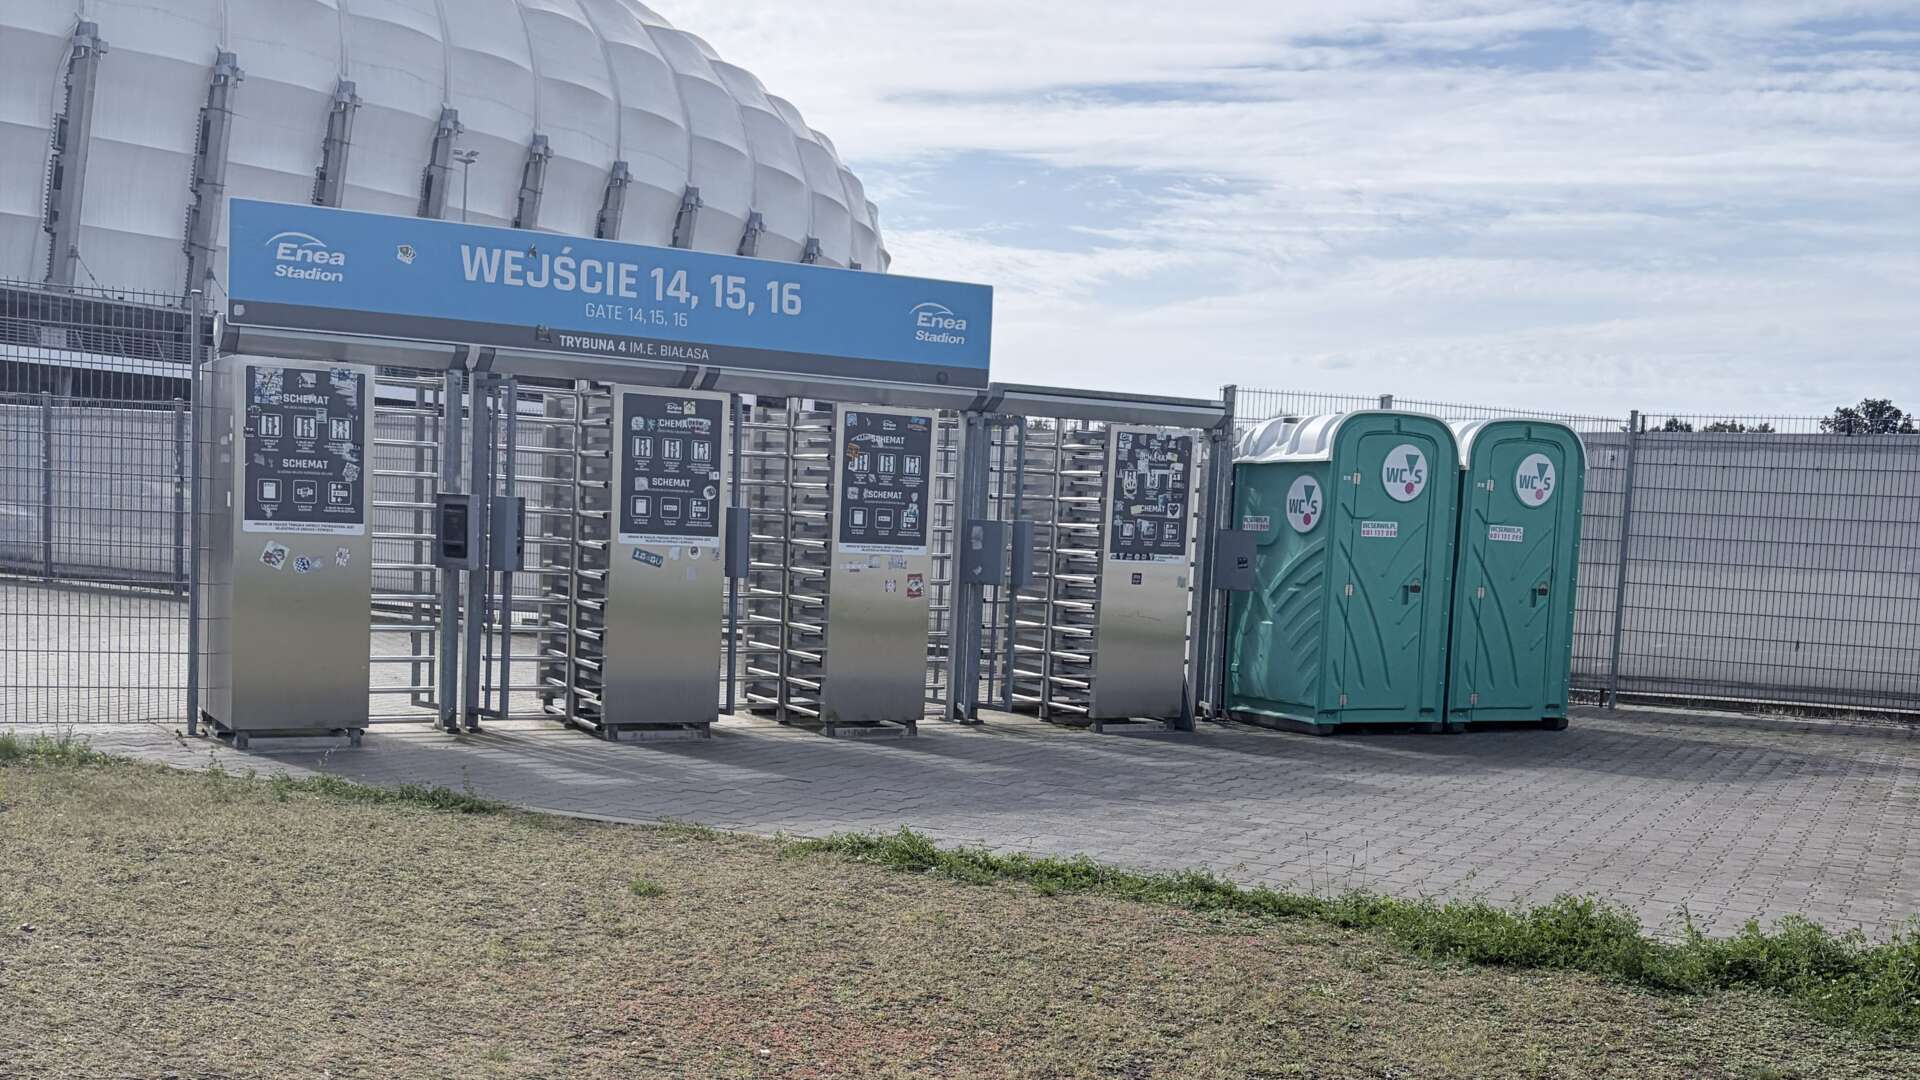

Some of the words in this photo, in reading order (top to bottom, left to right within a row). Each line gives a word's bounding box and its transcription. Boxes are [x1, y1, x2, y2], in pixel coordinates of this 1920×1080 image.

[276, 243, 345, 265] Enea
[274, 264, 343, 282] Stadion
[461, 244, 638, 299] WEJŚCIE
[650, 267, 699, 309] 14,
[710, 274, 755, 316] 15,
[766, 280, 803, 316] 16
[585, 303, 622, 321] GATE
[627, 306, 647, 325] 14,
[649, 309, 668, 326] 15,
[673, 312, 688, 327] 16
[917, 312, 966, 330] Enea
[915, 330, 964, 345] Stadion
[559, 335, 615, 351] TRYBUNA
[618, 340, 627, 353] 4
[629, 342, 657, 356] IM.E.
[660, 345, 709, 360] BIAŁASA
[283, 392, 330, 406] SCHEMAT
[282, 458, 329, 470] SCHEMAT
[652, 478, 691, 488] SCHEMAT
[868, 490, 903, 501] SCHEMAT
